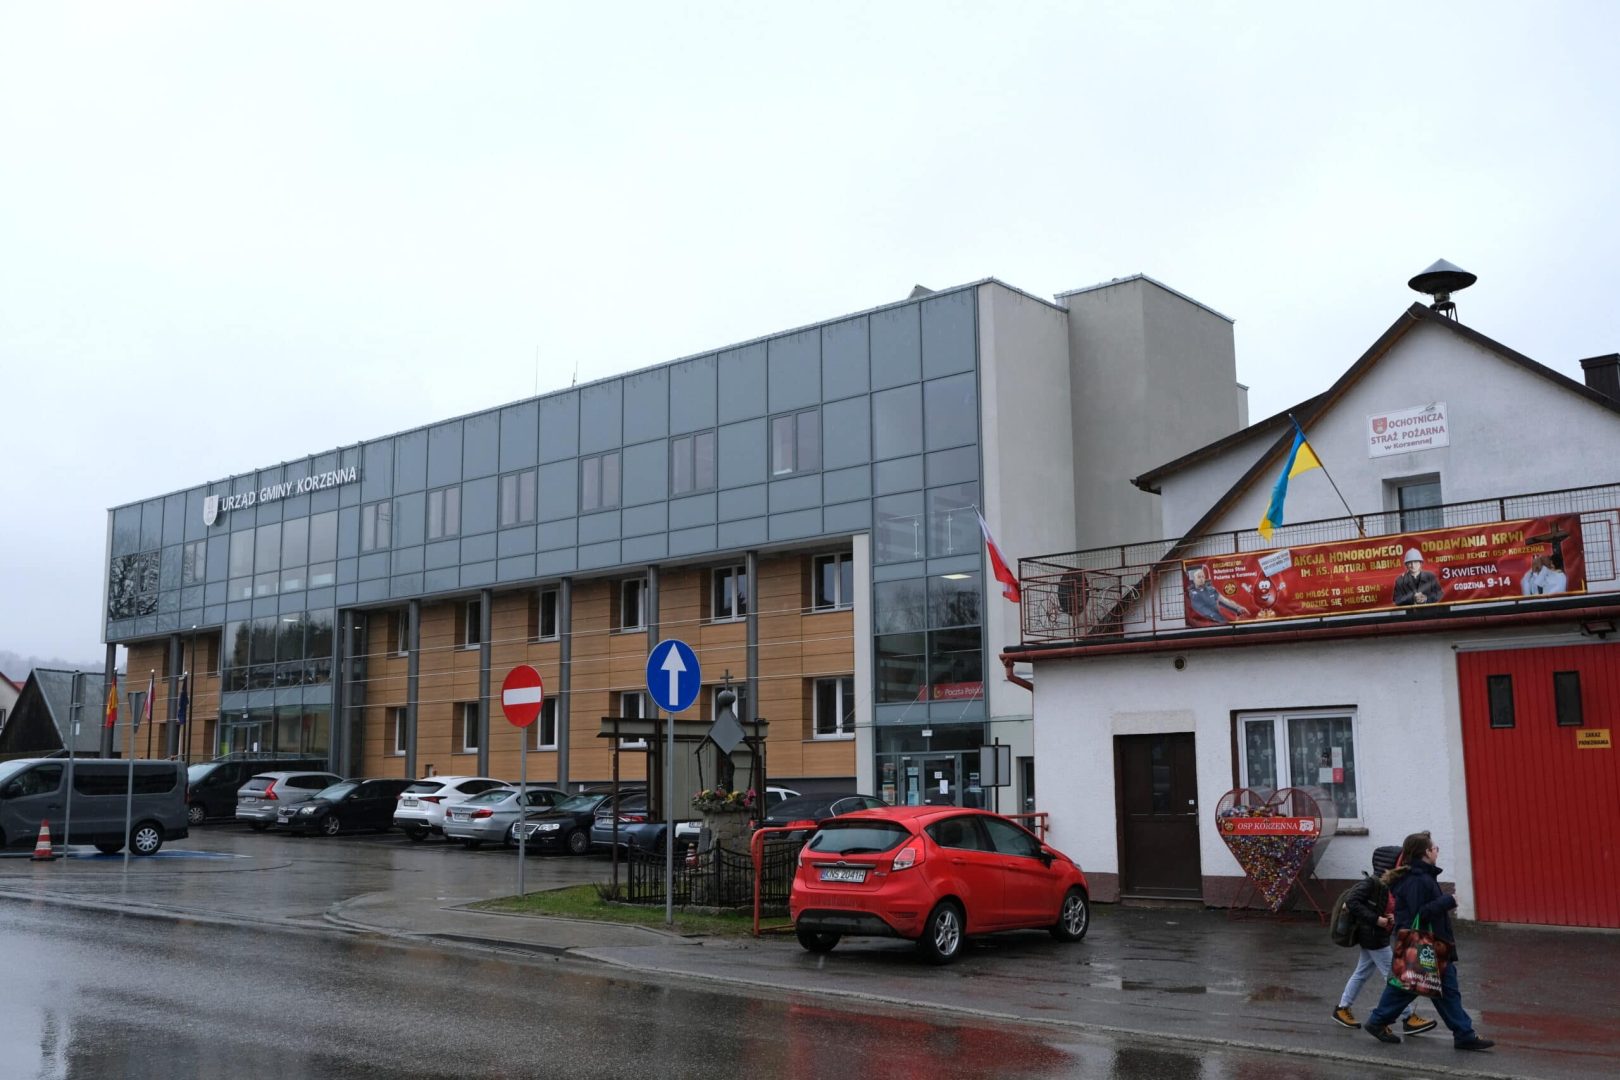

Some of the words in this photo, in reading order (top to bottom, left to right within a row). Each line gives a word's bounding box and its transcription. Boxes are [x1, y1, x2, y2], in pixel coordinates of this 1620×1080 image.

[1389, 413, 1444, 428] OCHOTNICZA
[1371, 432, 1398, 444] STRAŻ
[1402, 426, 1445, 439] POŻARNA
[1394, 438, 1432, 448] Korzennej
[222, 491, 256, 511] URZĄD
[259, 481, 293, 503] GMINY
[296, 466, 357, 494] KORZENNA
[1421, 535, 1487, 552] ODDAWANIA
[1492, 531, 1523, 544] KRWI
[1294, 556, 1325, 566] AKCJA
[1330, 545, 1403, 562] HONOROWEGO
[1332, 563, 1367, 574] ARTURA
[1442, 567, 1451, 579] 3
[1452, 565, 1497, 577] KWIETNIA
[1487, 576, 1511, 588] 9-14
[1331, 588, 1341, 596] TO
[944, 688, 964, 696] Poczta
[1237, 821, 1253, 830] OSP
[1254, 821, 1298, 830] KORZENNA
